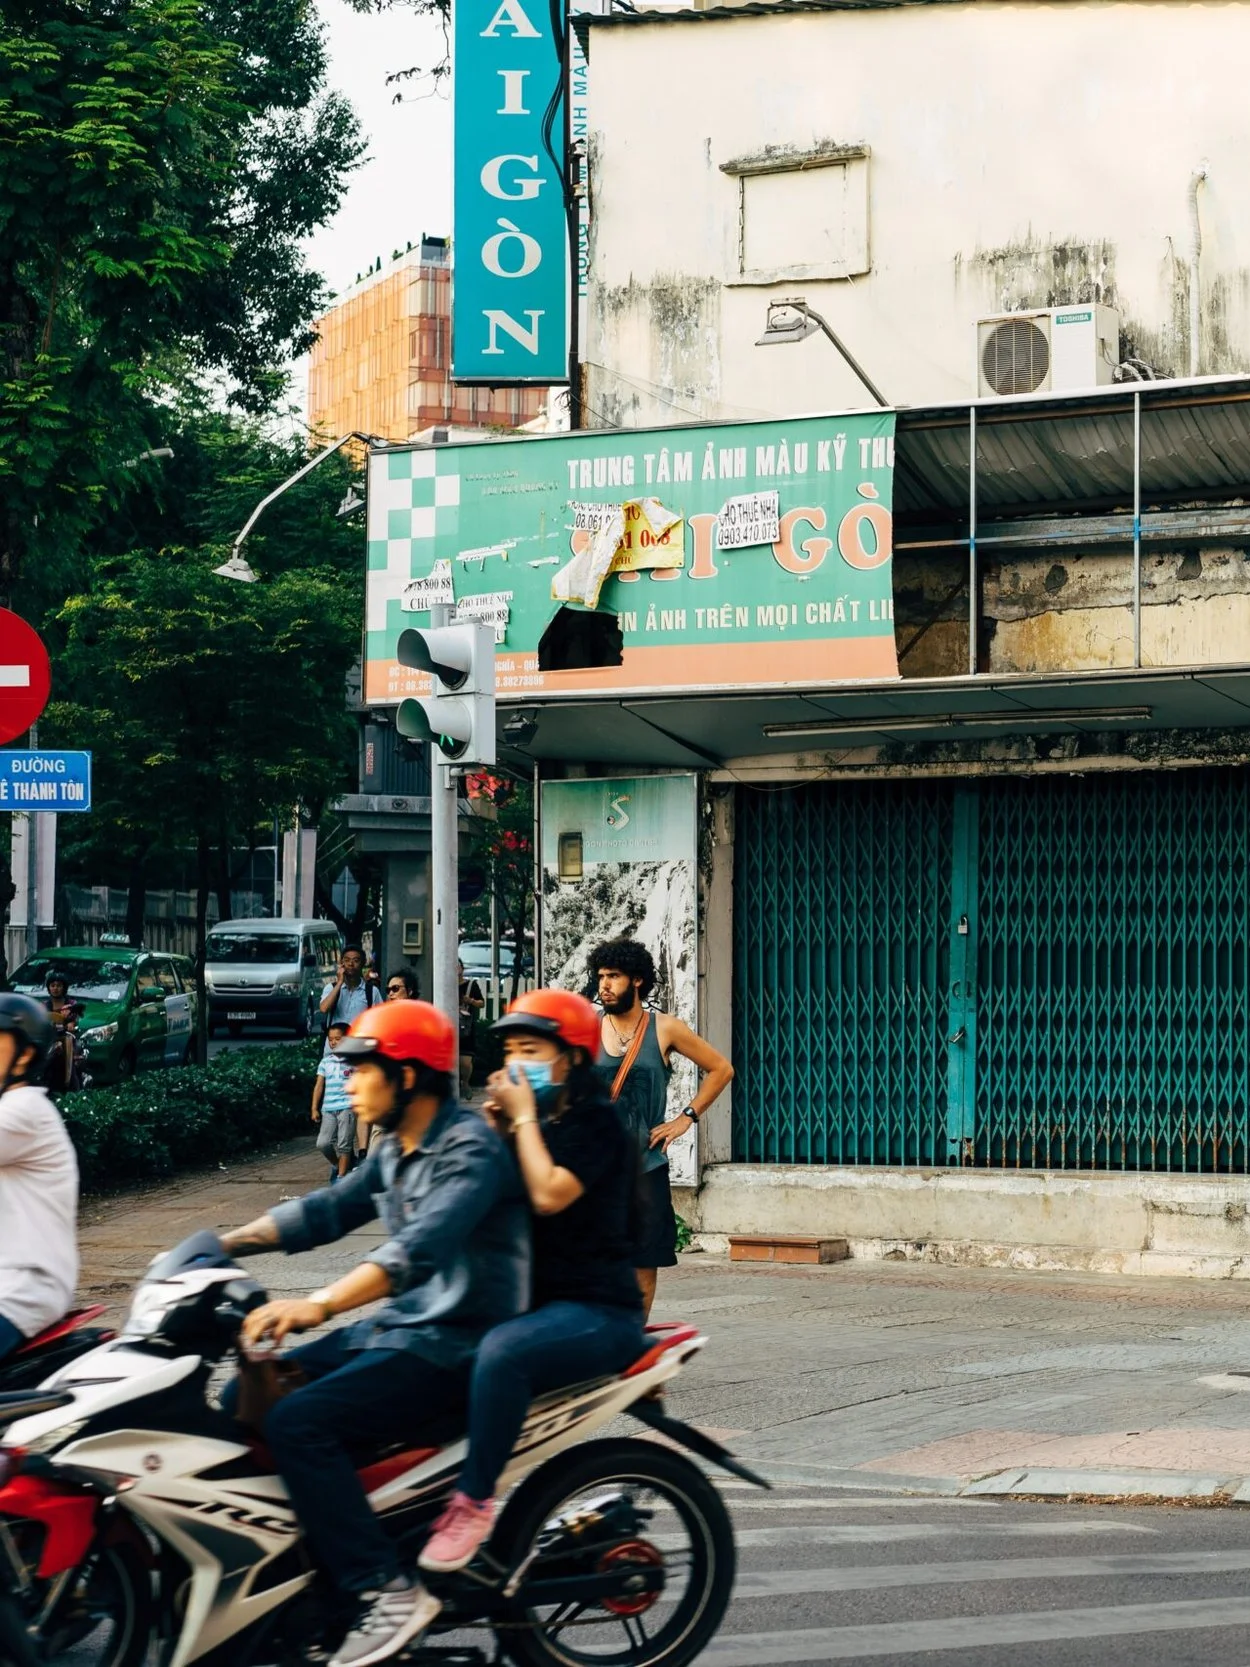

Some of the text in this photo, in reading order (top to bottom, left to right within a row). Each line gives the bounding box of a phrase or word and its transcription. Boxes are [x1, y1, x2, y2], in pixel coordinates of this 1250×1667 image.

[1058, 313, 1089, 323] TOSHIBA
[567, 455, 635, 489] TRUNG
[643, 447, 693, 484] TÂM
[701, 441, 747, 480] ẢNH
[755, 438, 808, 477] MÀU
[816, 432, 847, 472] KỸ
[718, 521, 778, 546] 0903.410.073
[645, 603, 687, 631] ẢNH
[694, 603, 749, 629] TRÊN
[757, 603, 797, 632] MỌI
[805, 594, 861, 625] CHẤT
[11, 756, 66, 773] ĐƯỜNG
[13, 779, 57, 800] THÁNH
[61, 779, 84, 801] TÔN
